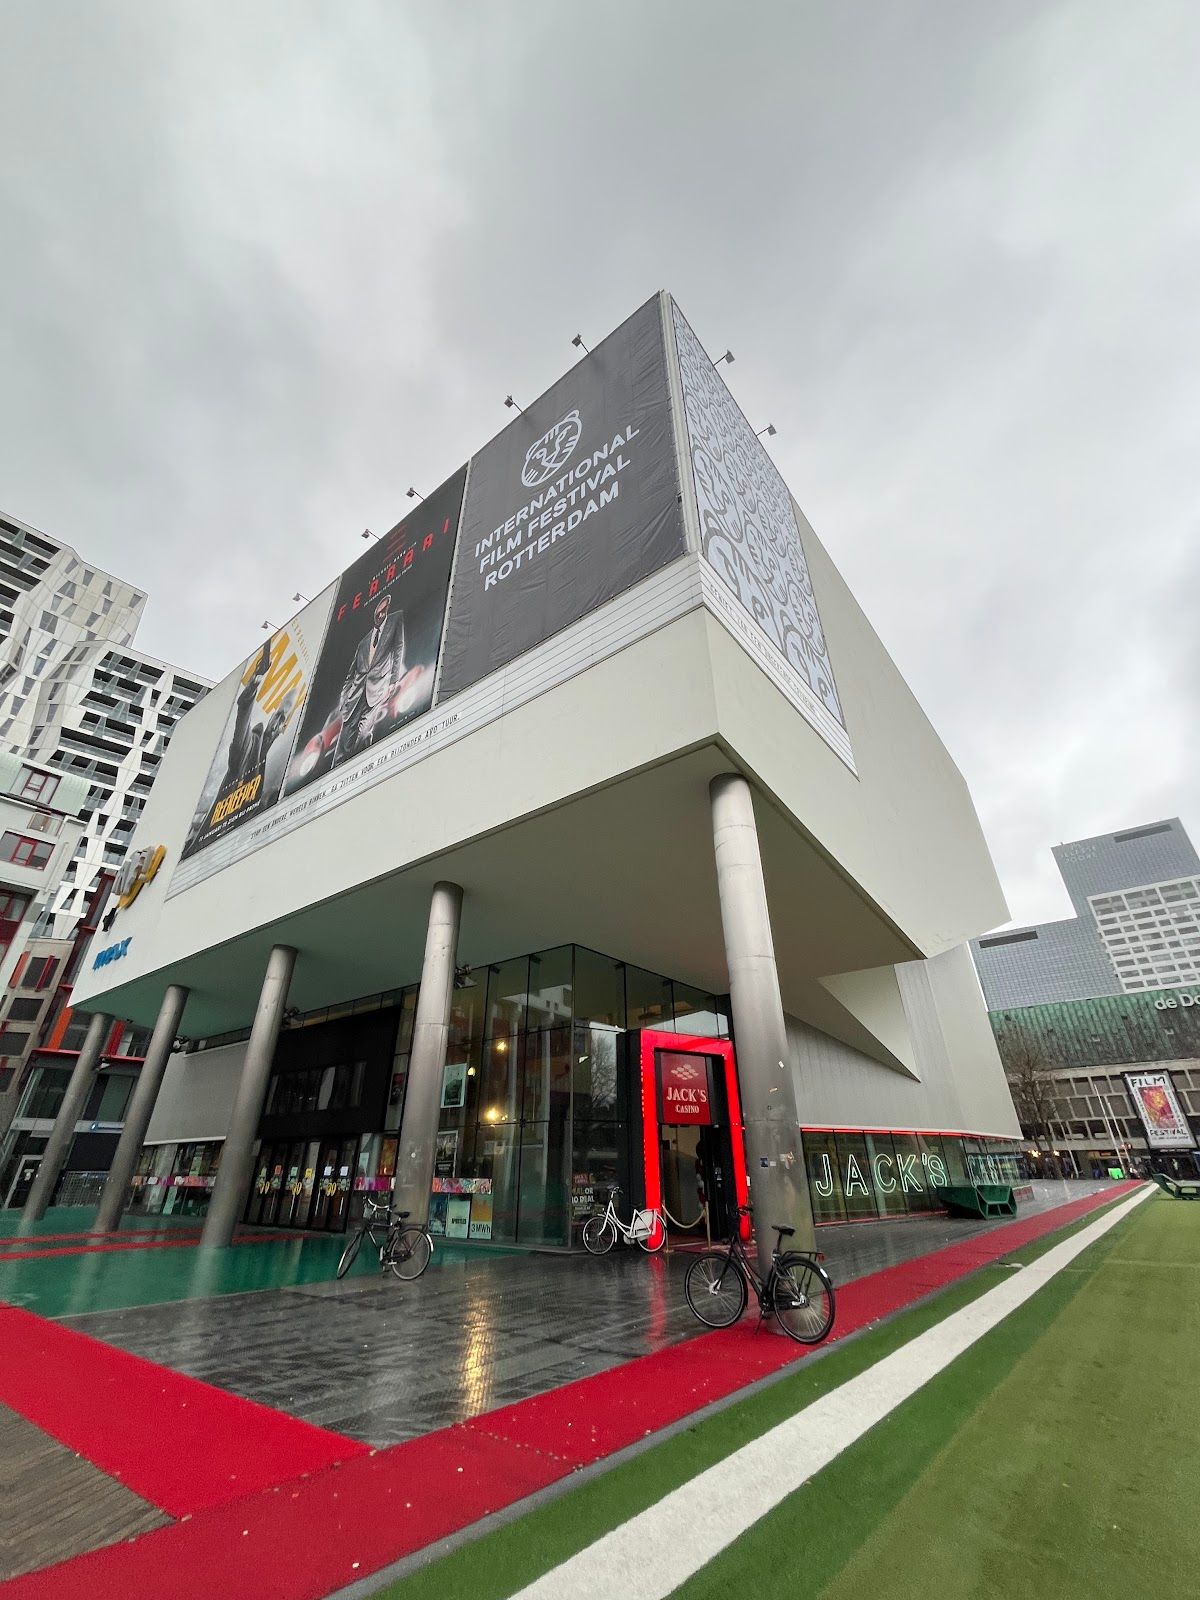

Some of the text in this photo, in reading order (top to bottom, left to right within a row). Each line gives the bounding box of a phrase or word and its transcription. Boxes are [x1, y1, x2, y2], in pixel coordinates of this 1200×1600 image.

[475, 425, 640, 558] INTERNATIONAL
[479, 530, 522, 574] FILM
[528, 454, 631, 538] FESTIVAL
[484, 481, 619, 591] ROTTERDAM
[337, 518, 449, 622] FERRARI
[210, 774, 262, 828] BEEKEEPER
[1154, 996, 1178, 1010] de
[666, 1086, 707, 1103] JACK'S
[1130, 1076, 1166, 1088] FILM
[675, 1104, 700, 1114] CASINO
[1149, 1128, 1187, 1136] FESTIVAL
[815, 1153, 948, 1197] JACK'S
[471, 1223, 491, 1233] 3MWh
